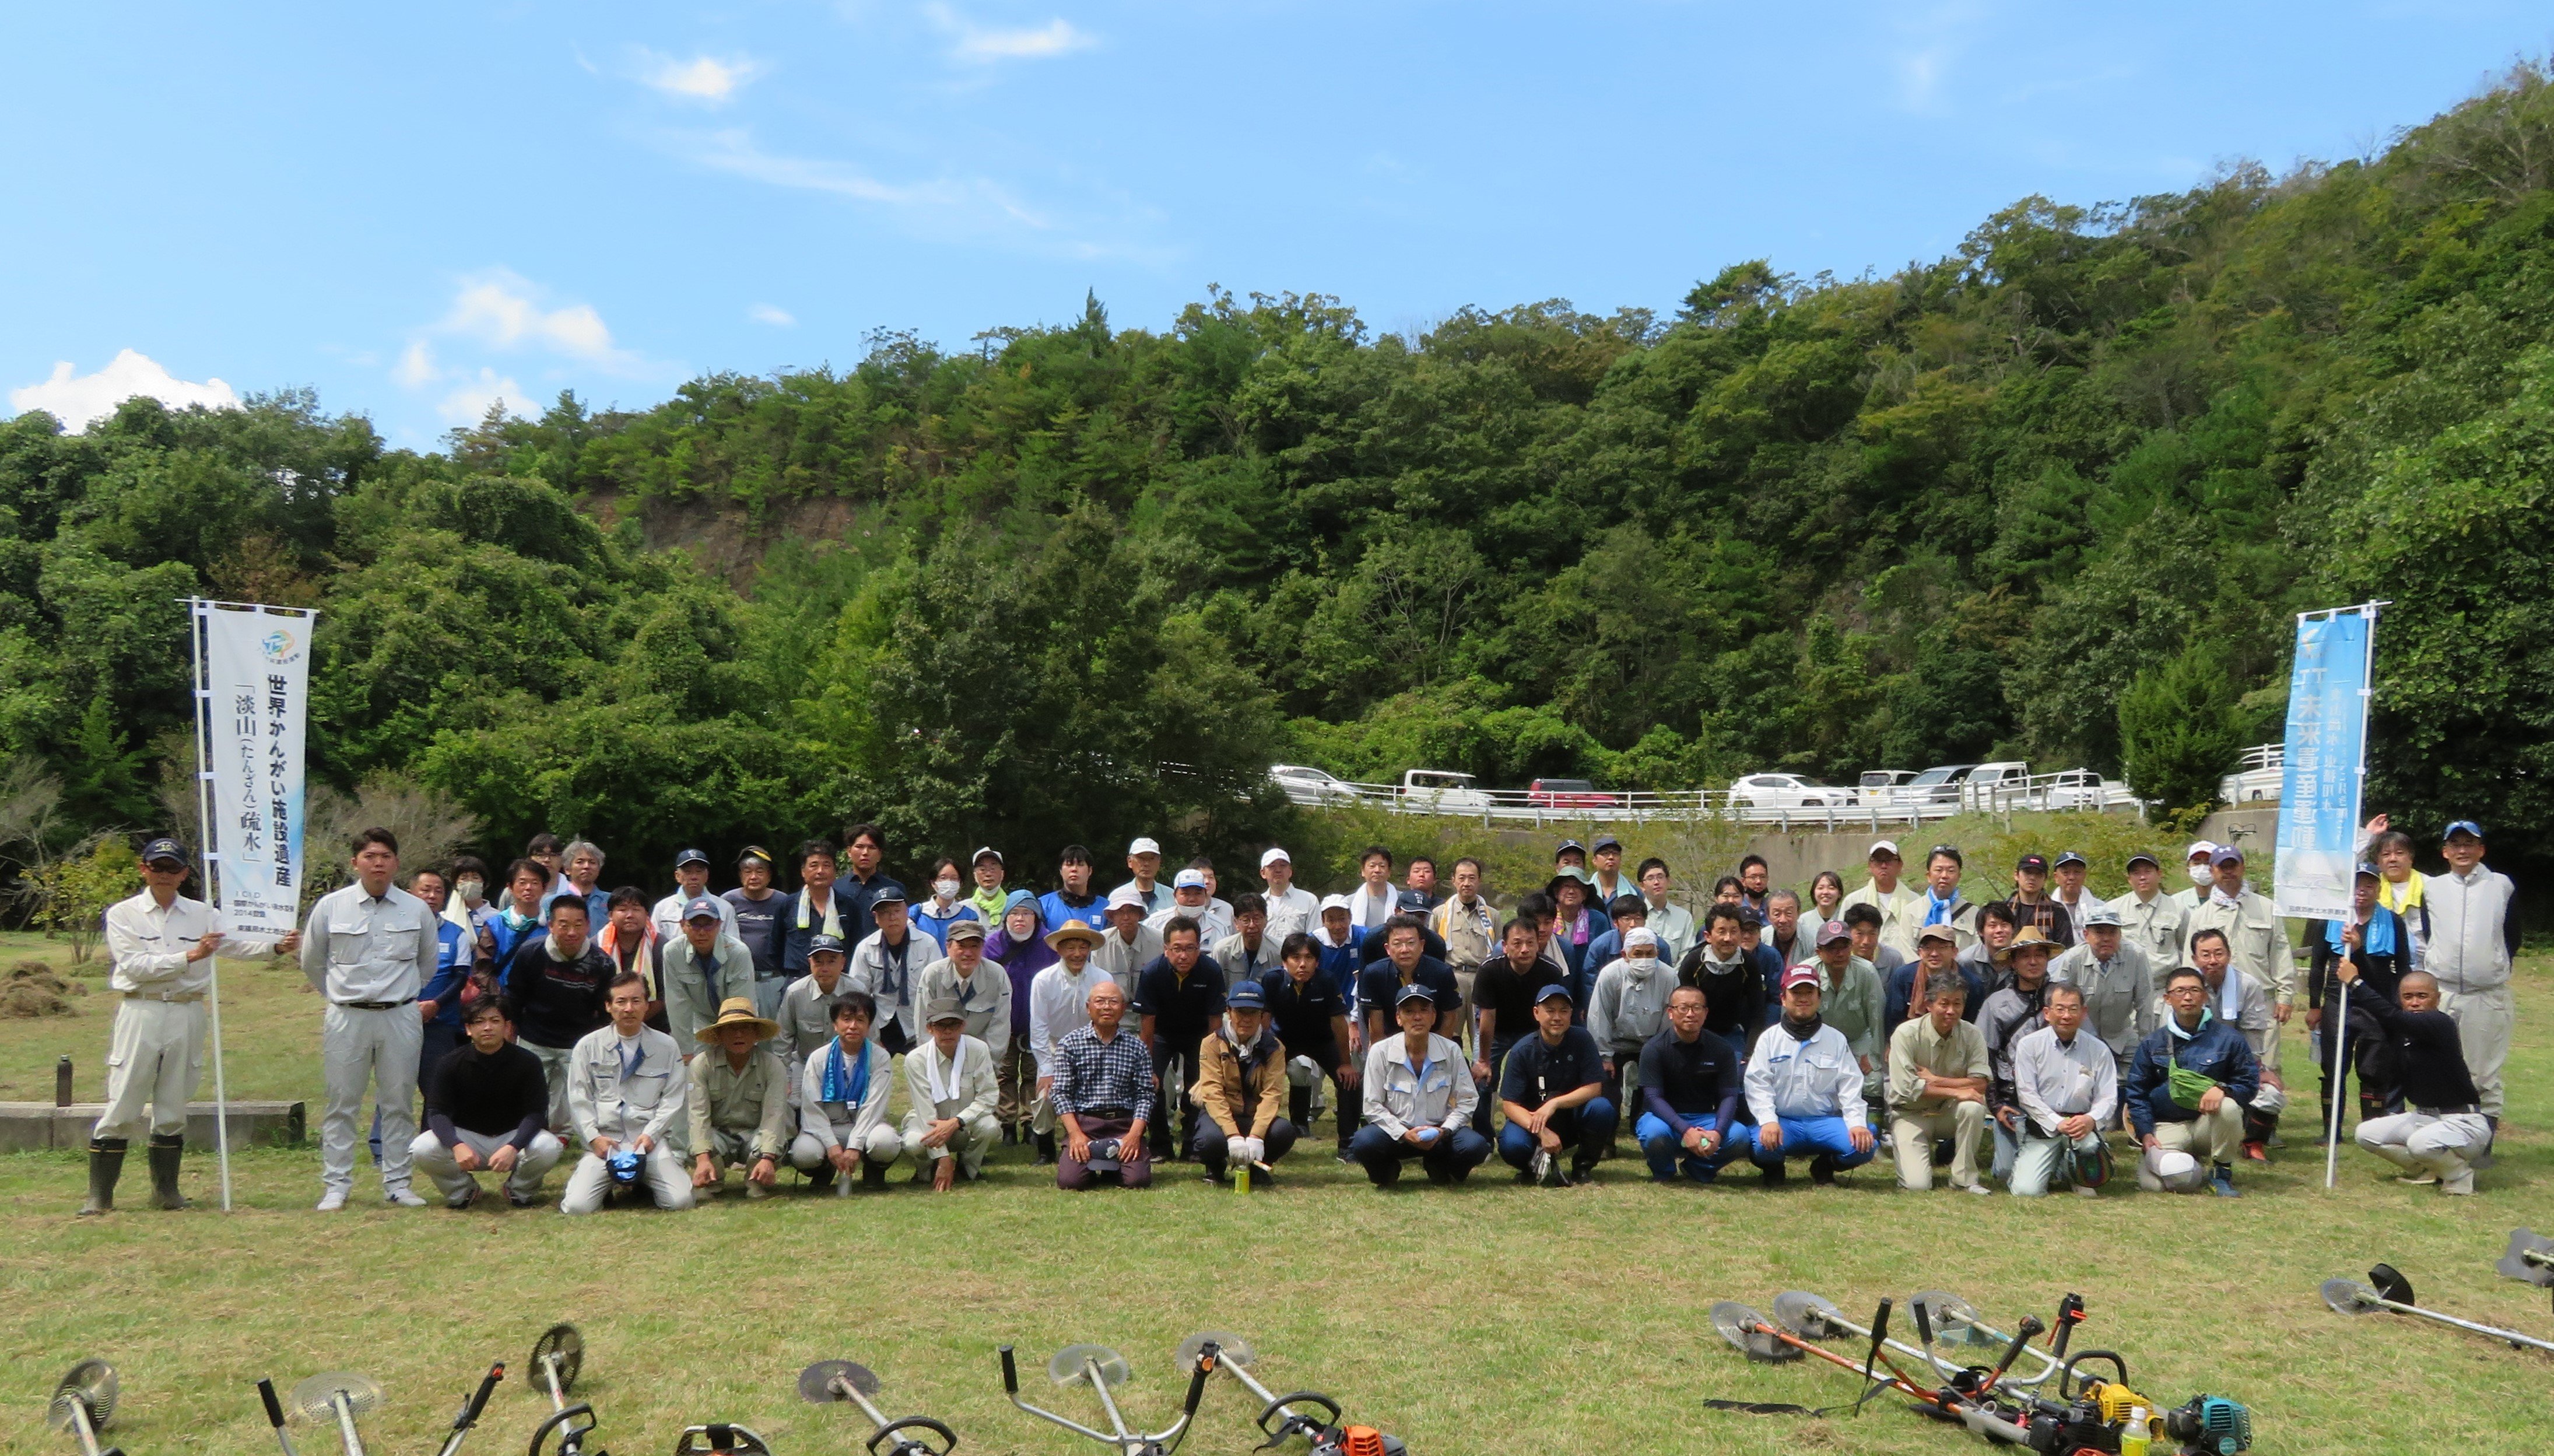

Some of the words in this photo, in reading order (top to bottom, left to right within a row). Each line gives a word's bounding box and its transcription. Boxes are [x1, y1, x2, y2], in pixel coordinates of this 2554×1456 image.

[267, 673, 292, 887] 世界かんがい施設遺産
